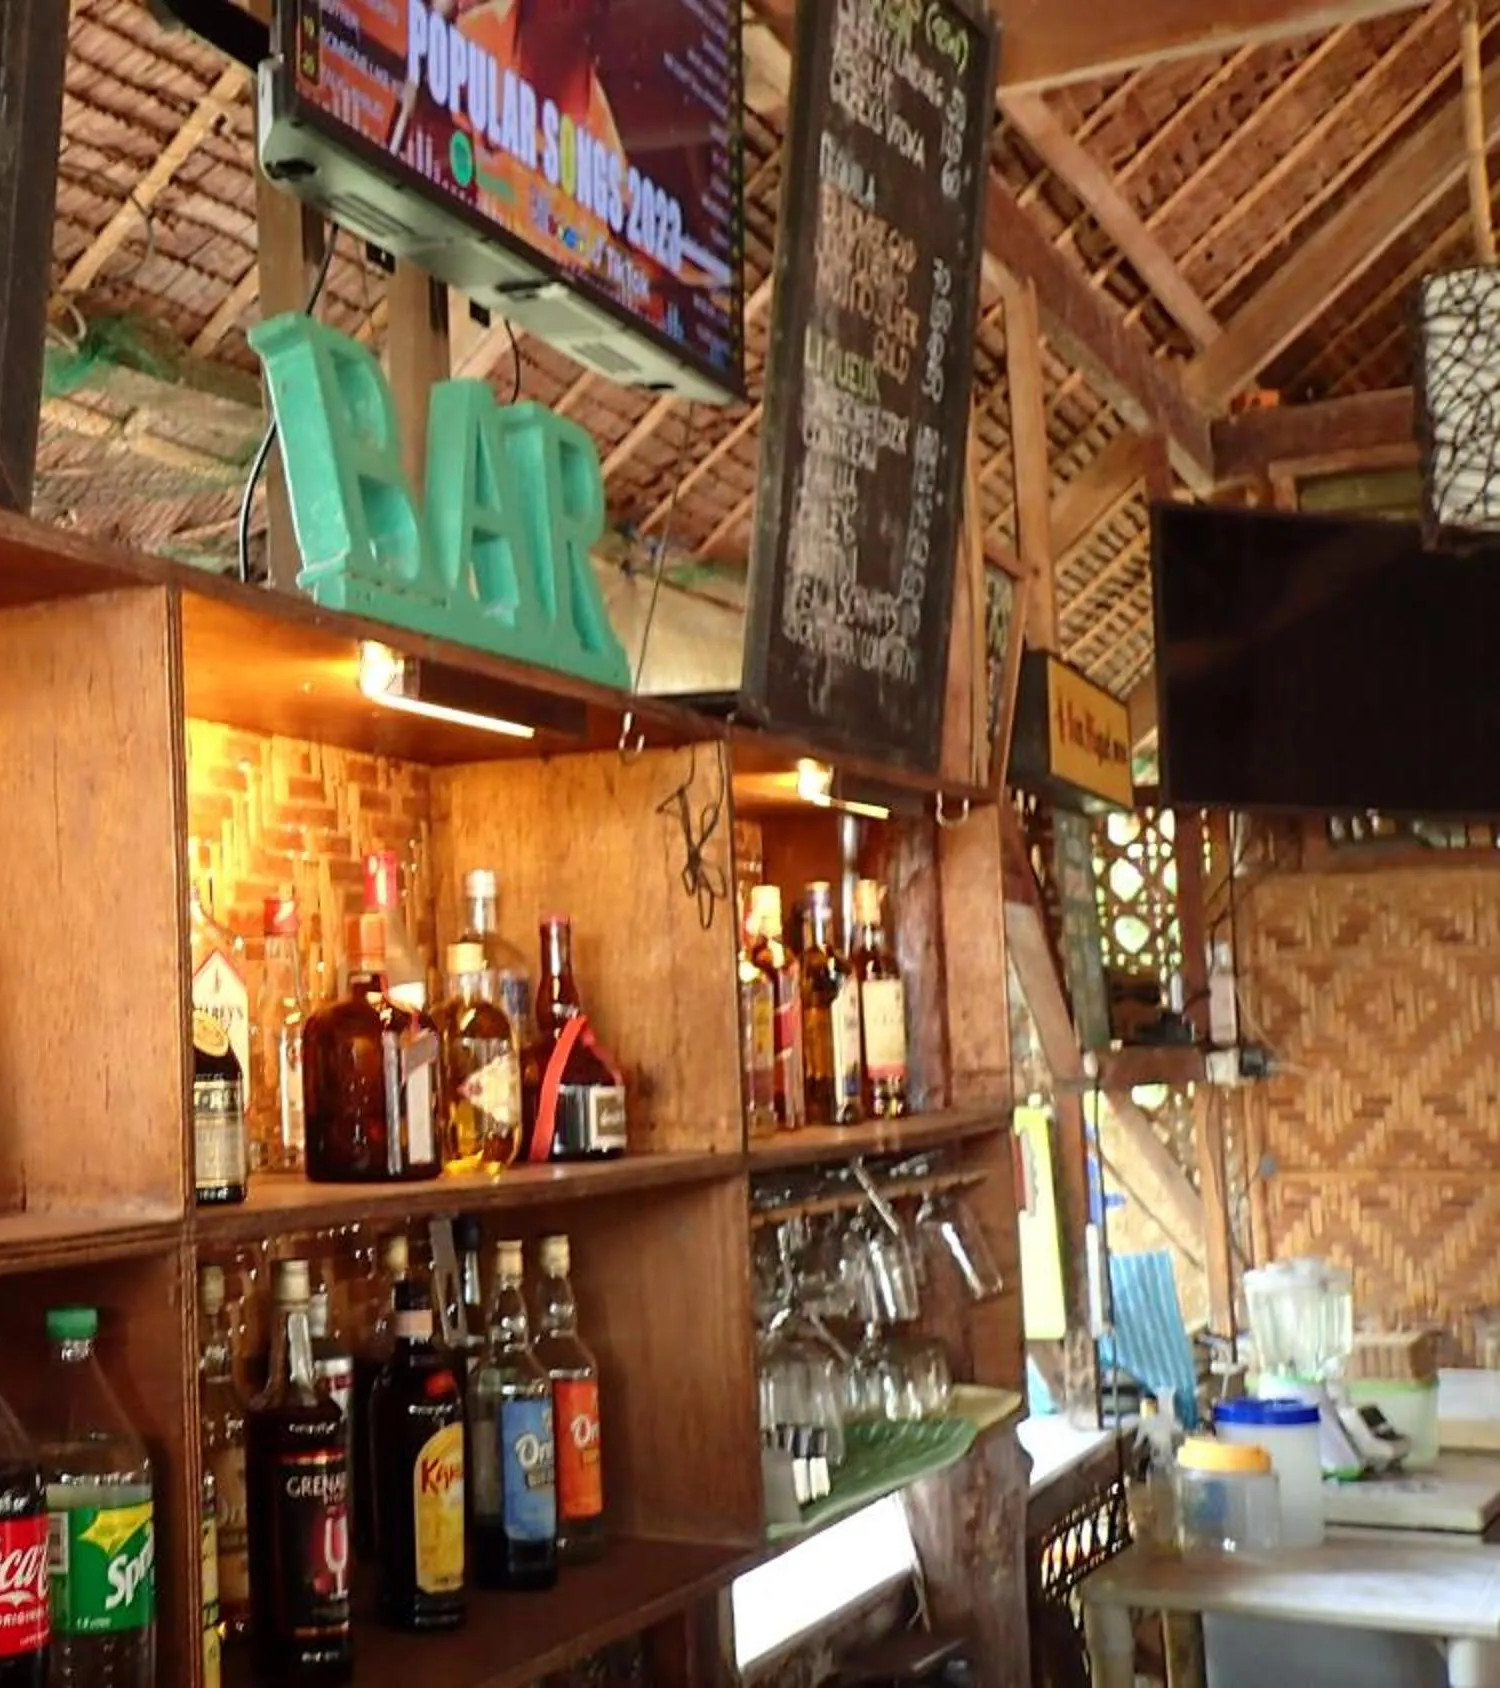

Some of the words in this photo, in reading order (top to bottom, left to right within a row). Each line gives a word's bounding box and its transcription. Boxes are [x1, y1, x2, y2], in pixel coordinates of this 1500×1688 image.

[407, 0, 537, 170] POPULAR
[542, 97, 623, 233] SONGS
[626, 165, 683, 274] 2023
[247, 310, 631, 691] BAR
